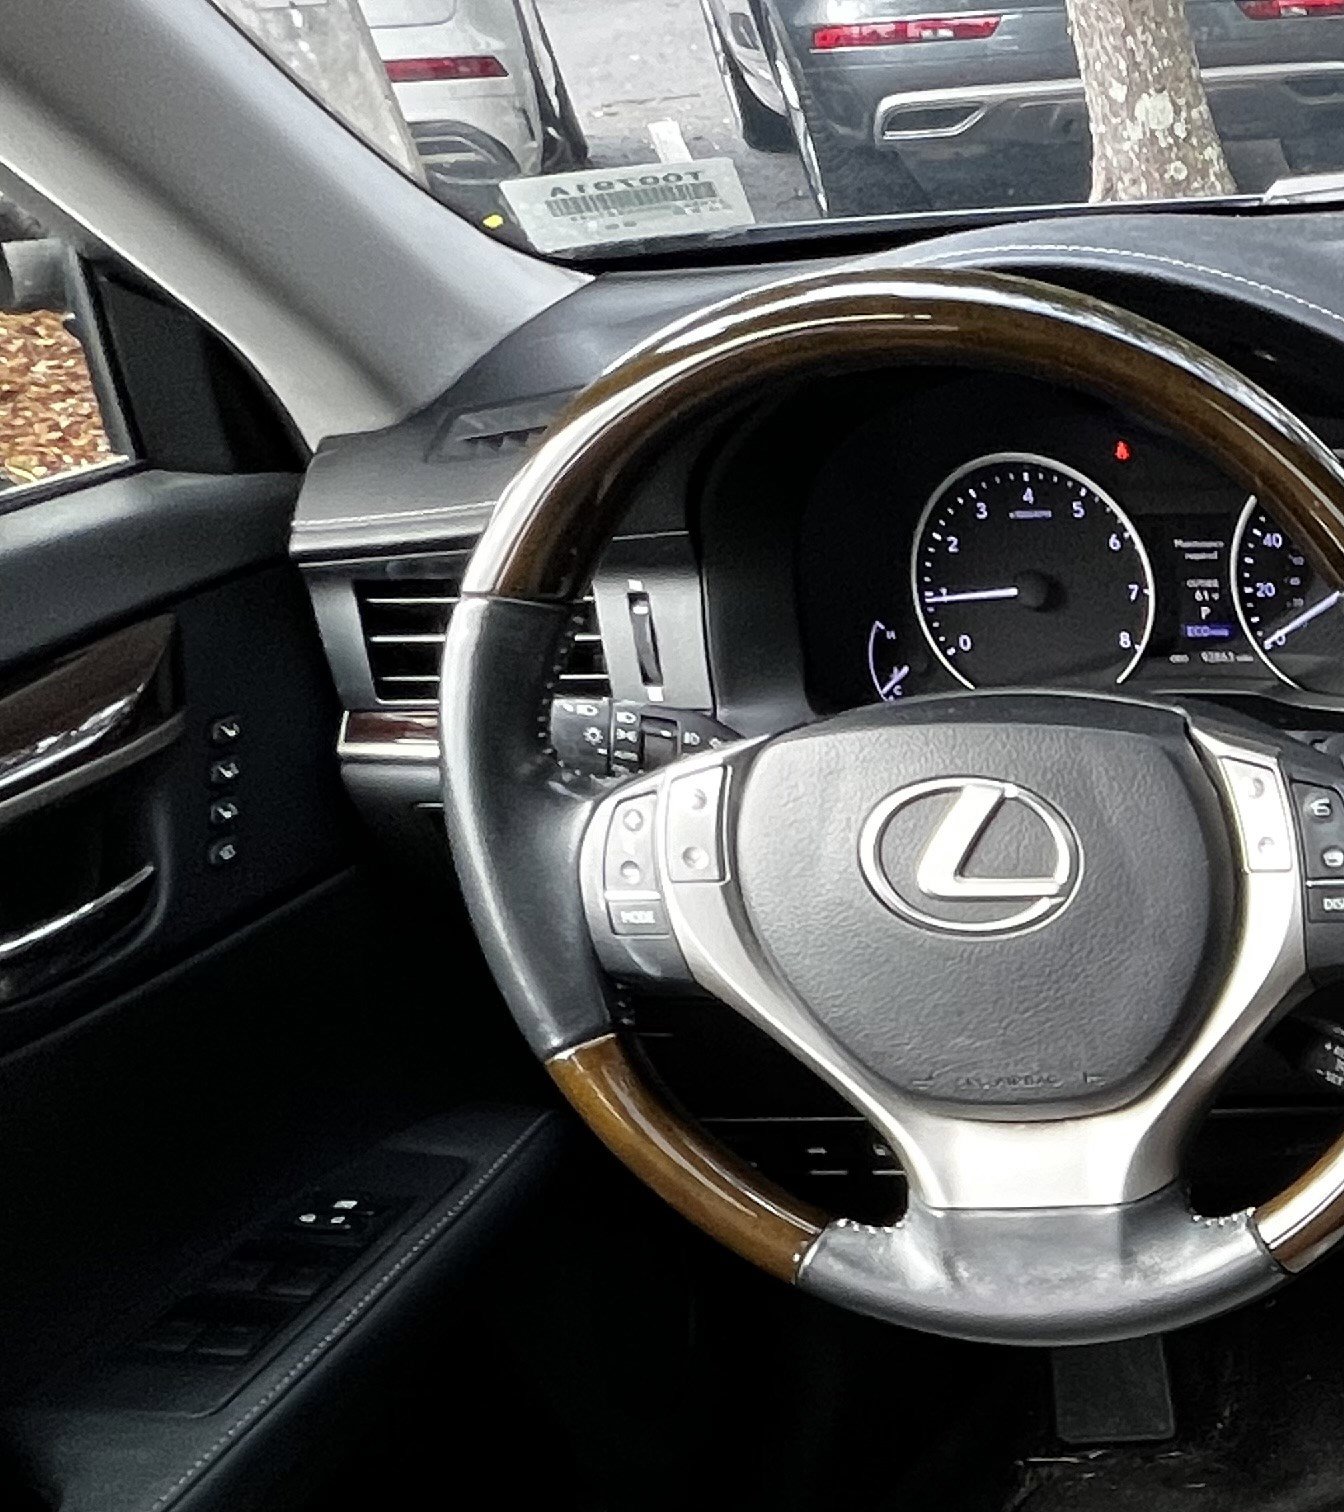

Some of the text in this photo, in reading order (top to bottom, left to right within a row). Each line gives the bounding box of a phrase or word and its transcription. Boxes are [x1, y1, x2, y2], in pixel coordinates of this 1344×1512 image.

[1022, 486, 1034, 505] 4
[976, 501, 988, 520] 3
[1072, 500, 1085, 518] 5
[946, 536, 960, 552] 2
[1108, 533, 1122, 551] 6
[1263, 533, 1283, 549] 40
[1128, 584, 1139, 602] 7
[1256, 582, 1276, 598] 20
[1200, 606, 1211, 620] P
[958, 634, 972, 652] 0
[1118, 631, 1132, 649] 8
